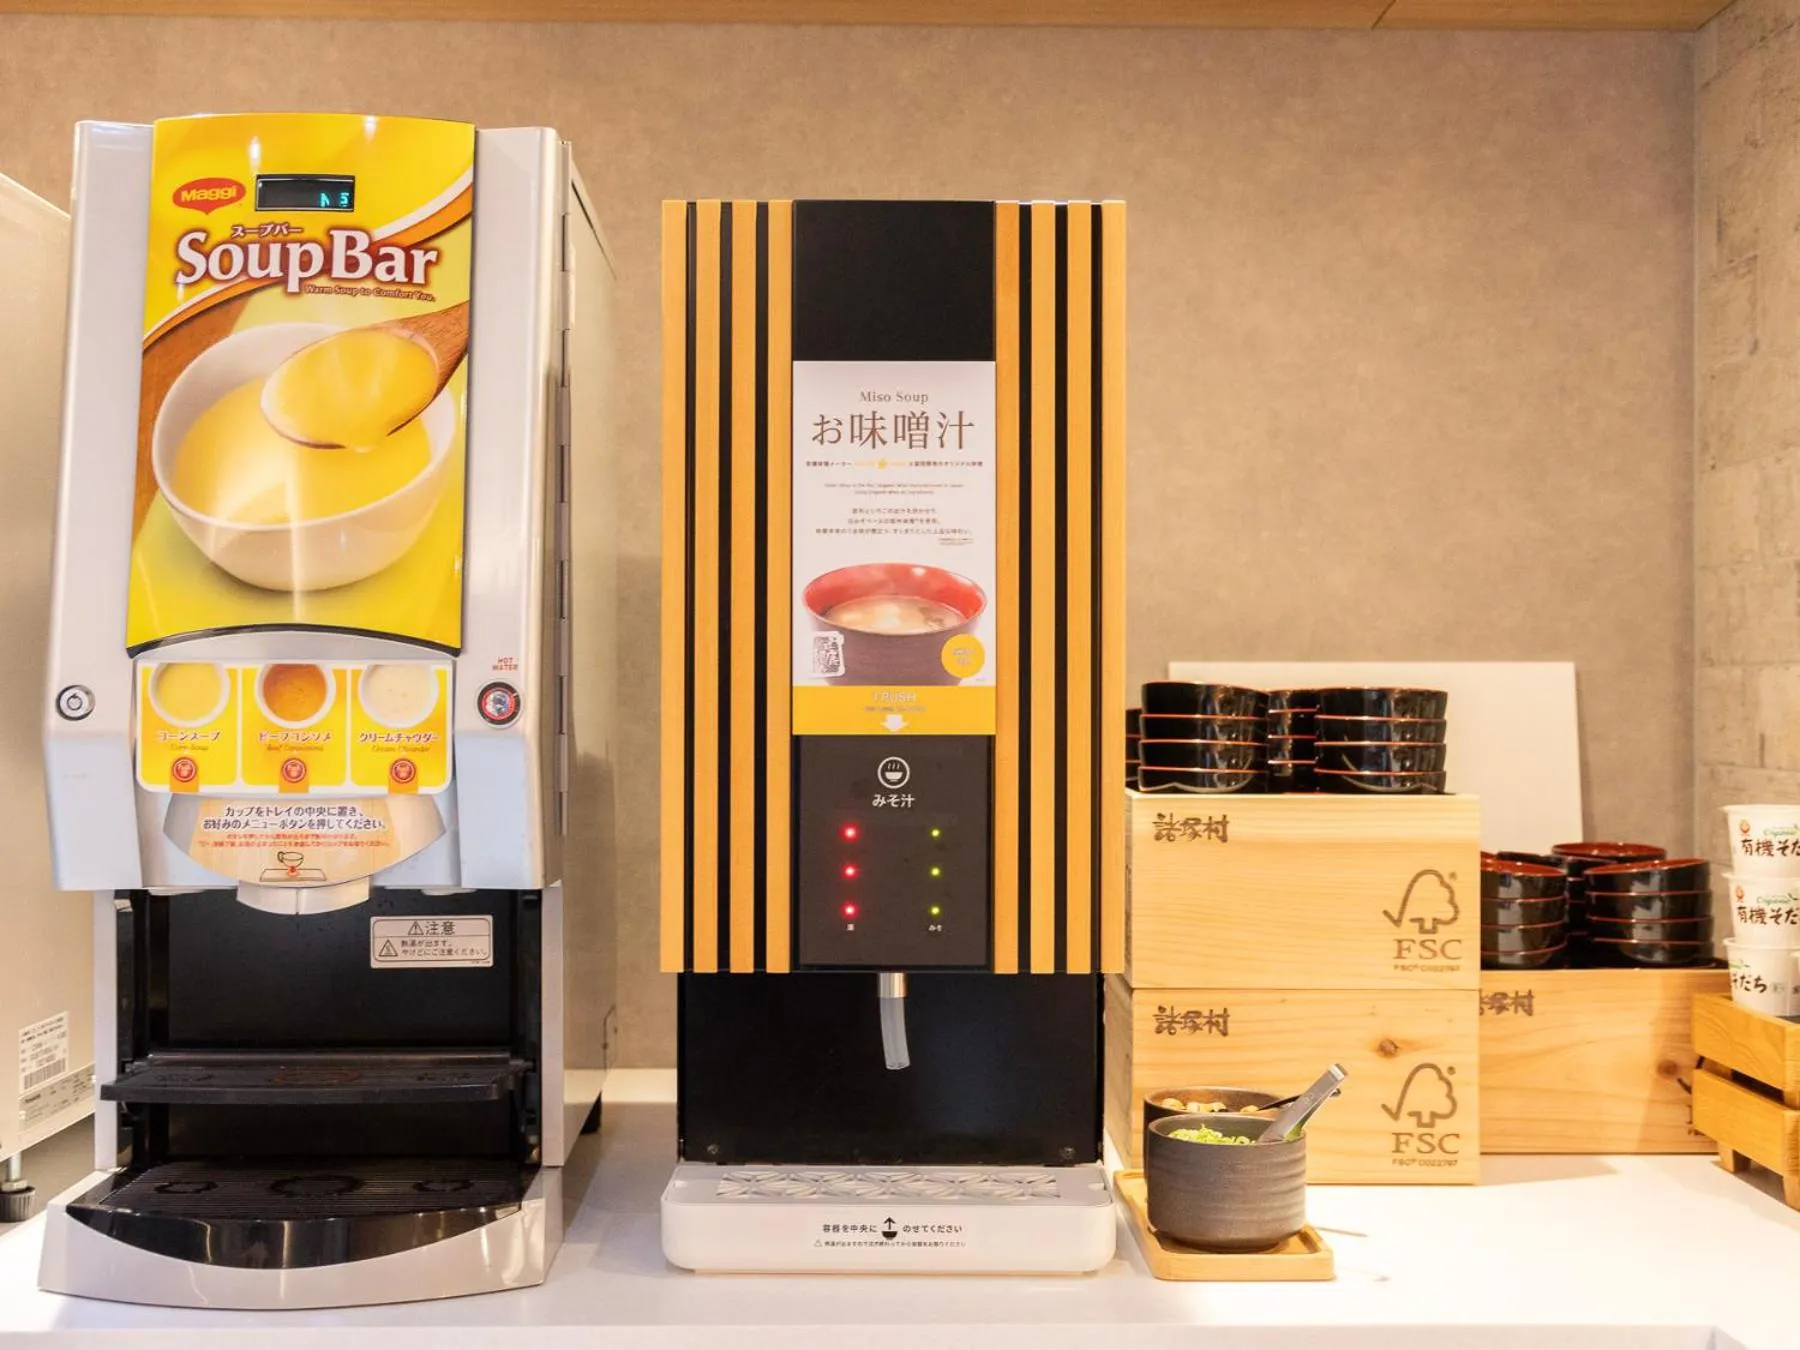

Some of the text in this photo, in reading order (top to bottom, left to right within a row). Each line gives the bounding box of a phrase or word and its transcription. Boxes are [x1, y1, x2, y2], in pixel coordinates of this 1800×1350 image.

[180, 186, 238, 203] Maggi
[231, 221, 302, 238] スープバー
[334, 285, 360, 297] Soup
[374, 287, 413, 299] Comfort
[860, 391, 929, 404] Miso Soup
[811, 410, 975, 450] お味噌汁
[158, 731, 222, 742] コーンスープ
[259, 732, 332, 742] ビーフコンソメ
[359, 732, 438, 743] クリームチャウダー
[872, 794, 915, 808] みそ汁
[225, 806, 363, 817] カップをトレイの中央に置き、
[203, 818, 387, 830] お好みのメニューボタンを押してください。
[424, 921, 456, 935] 注意
[1392, 938, 1462, 960] FSC
[1391, 1132, 1460, 1154] FSC
[823, 1224, 963, 1233] 容器を中央に のせてください
